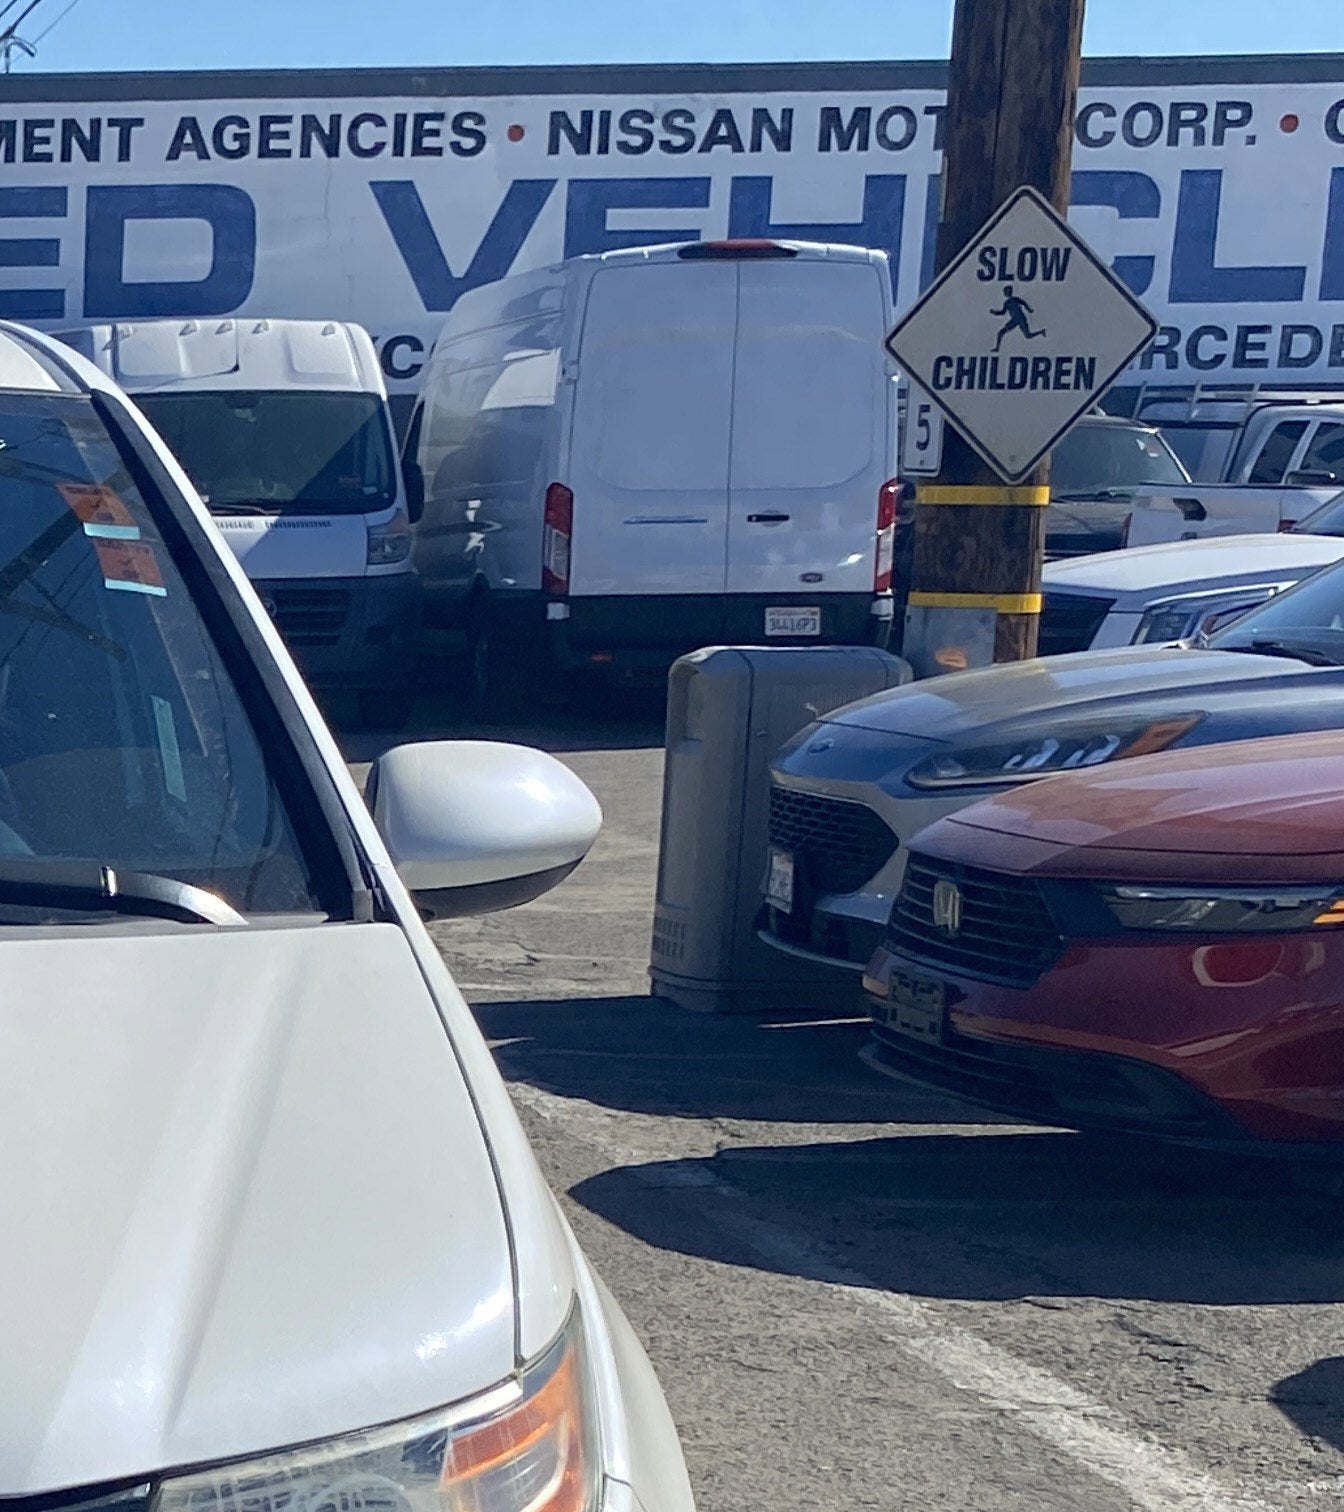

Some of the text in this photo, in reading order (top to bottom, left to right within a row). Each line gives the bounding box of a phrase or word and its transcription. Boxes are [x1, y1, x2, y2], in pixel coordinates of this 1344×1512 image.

[165, 110, 487, 162] AGENCIES
[546, 107, 795, 157] NISSAN
[1074, 100, 1257, 148] CORP.
[976, 246, 1072, 282] SLOW
[932, 356, 1097, 391] CHILDREN
[915, 403, 932, 451] 5
